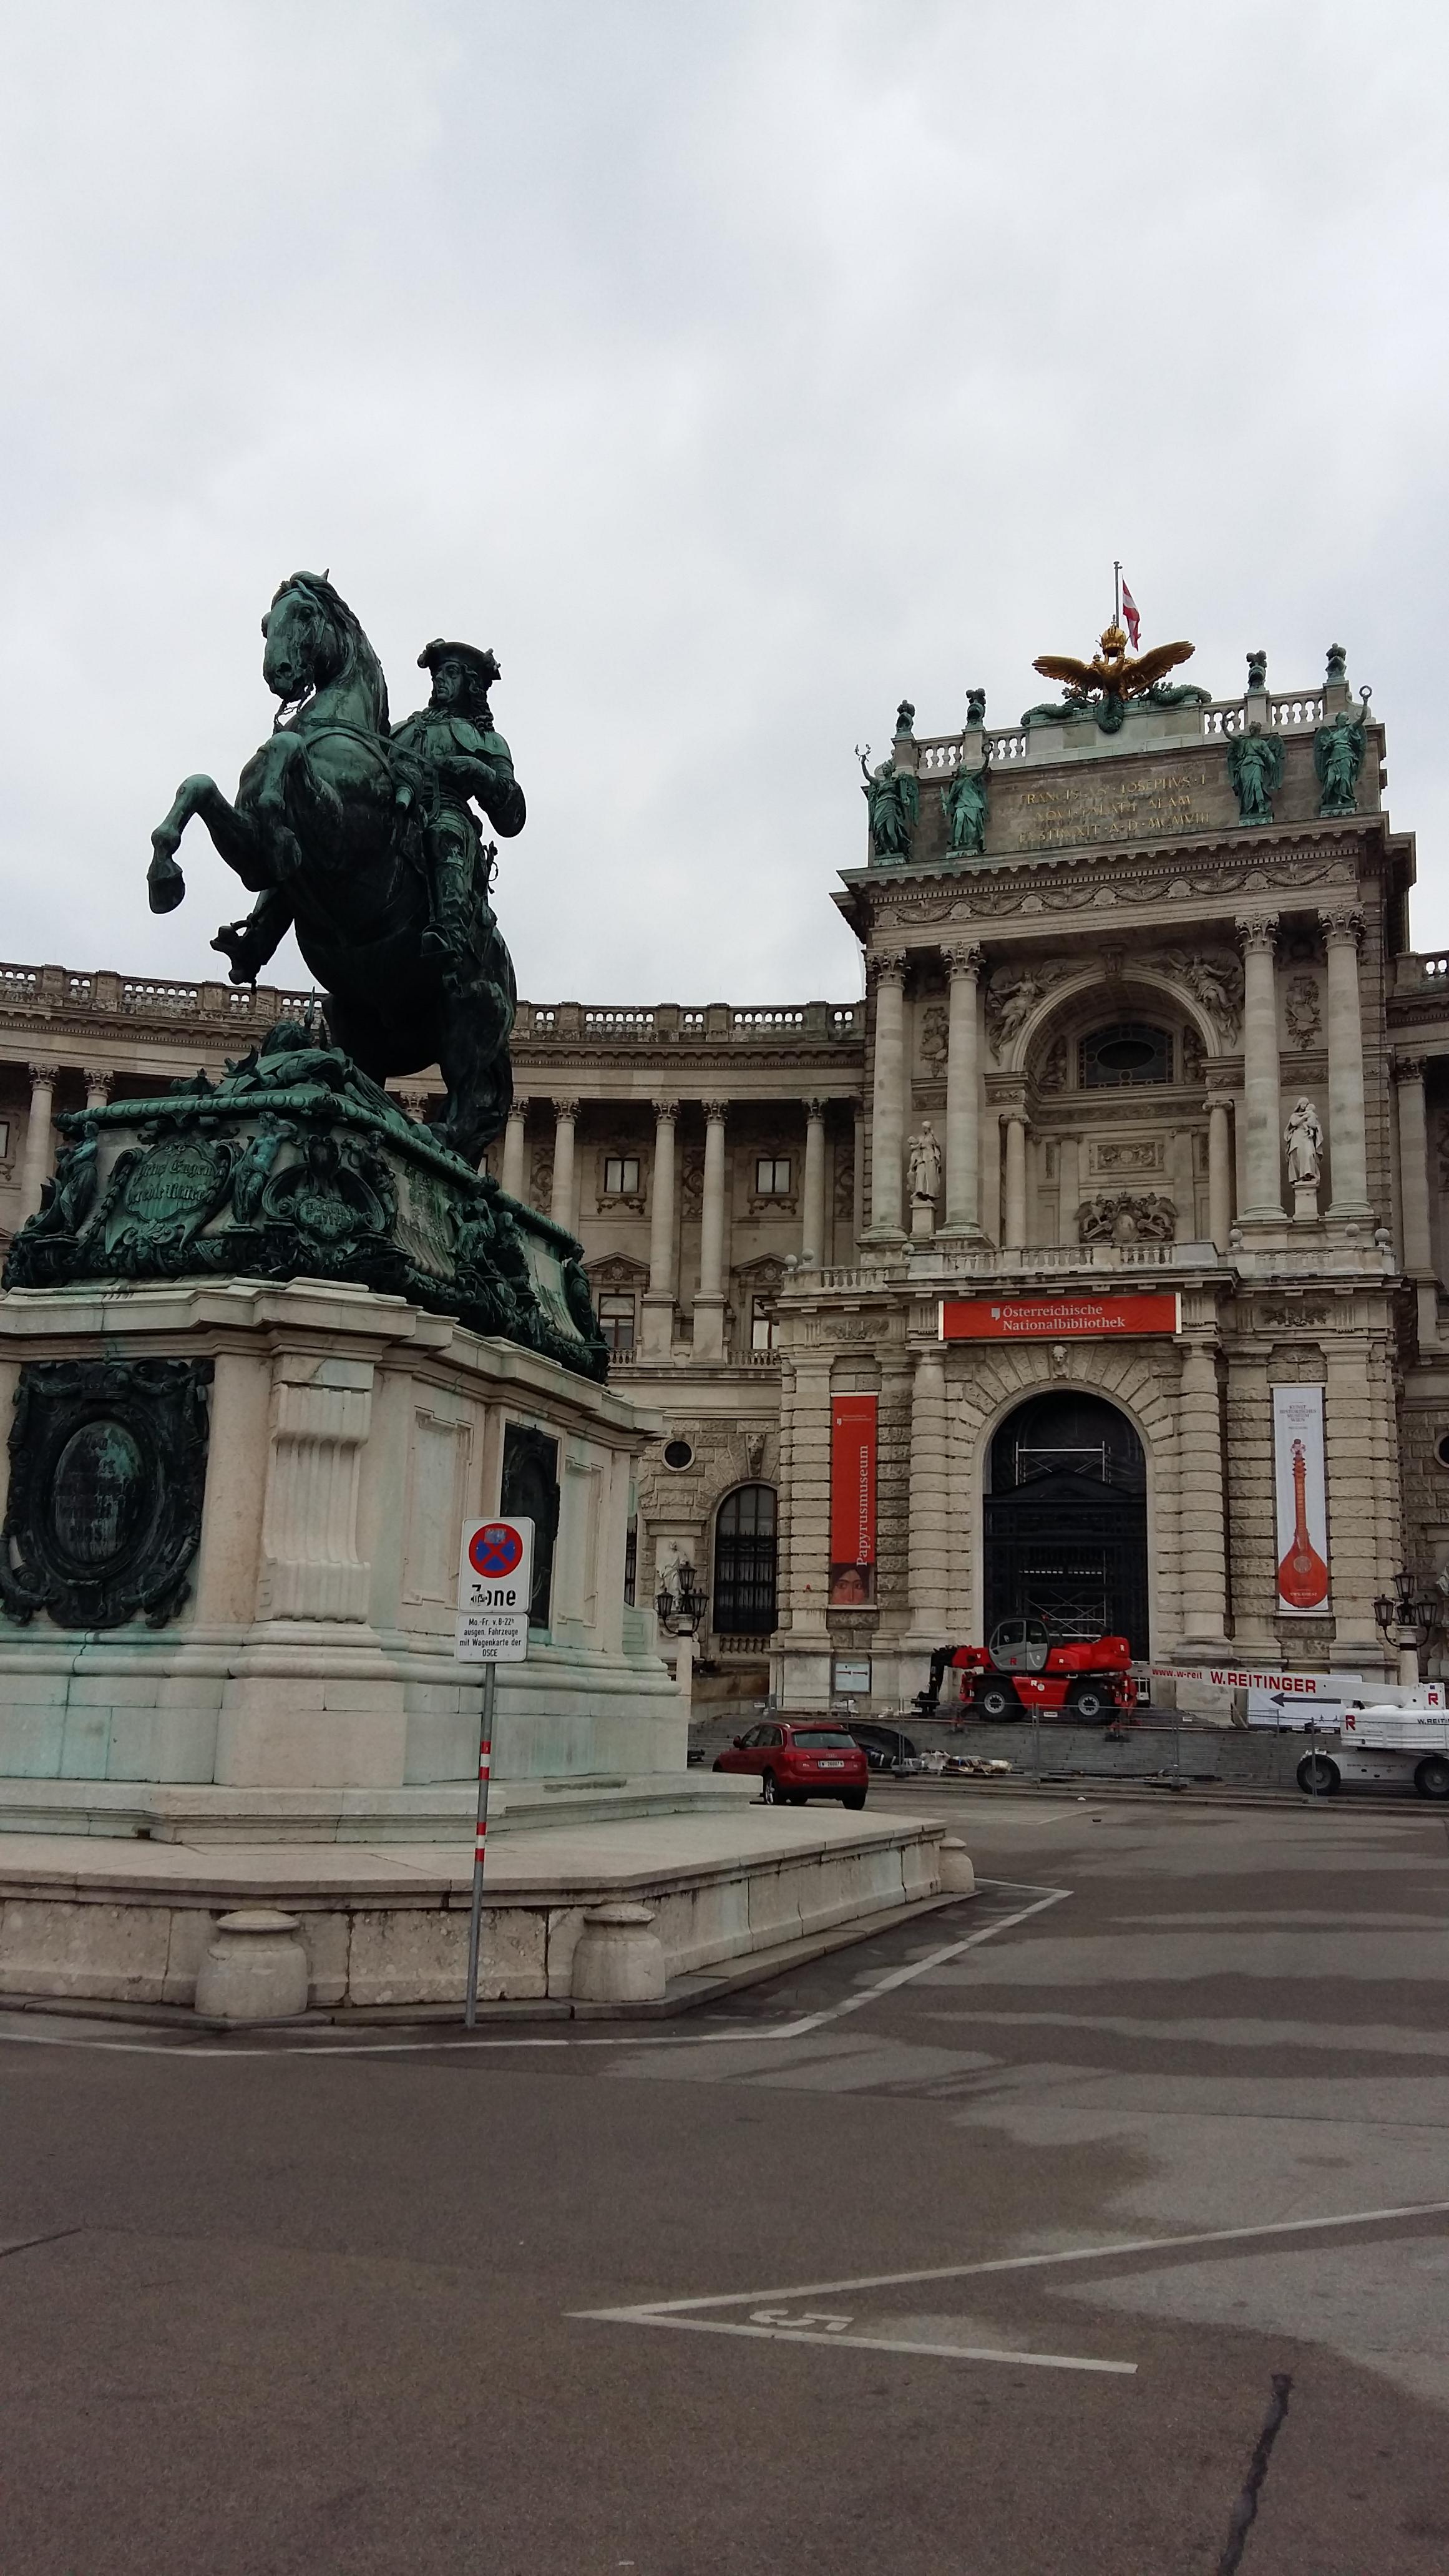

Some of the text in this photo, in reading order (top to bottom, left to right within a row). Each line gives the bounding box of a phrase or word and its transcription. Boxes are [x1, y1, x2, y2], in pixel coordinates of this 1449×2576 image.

[1003, 1305, 1103, 1317] Österreichische
[1003, 1317, 1126, 1331] Nationalbibliothek
[856, 1445, 871, 1567] Papyrusmuseum
[488, 1627, 519, 1637] Fahrzeuge
[472, 1638, 509, 1648] Wagenkarte
[482, 1649, 498, 1657] OSCE
[1210, 1671, 1316, 1694] W.REITINGER
[1428, 1692, 1439, 1706] R
[1345, 1714, 1357, 1732] R
